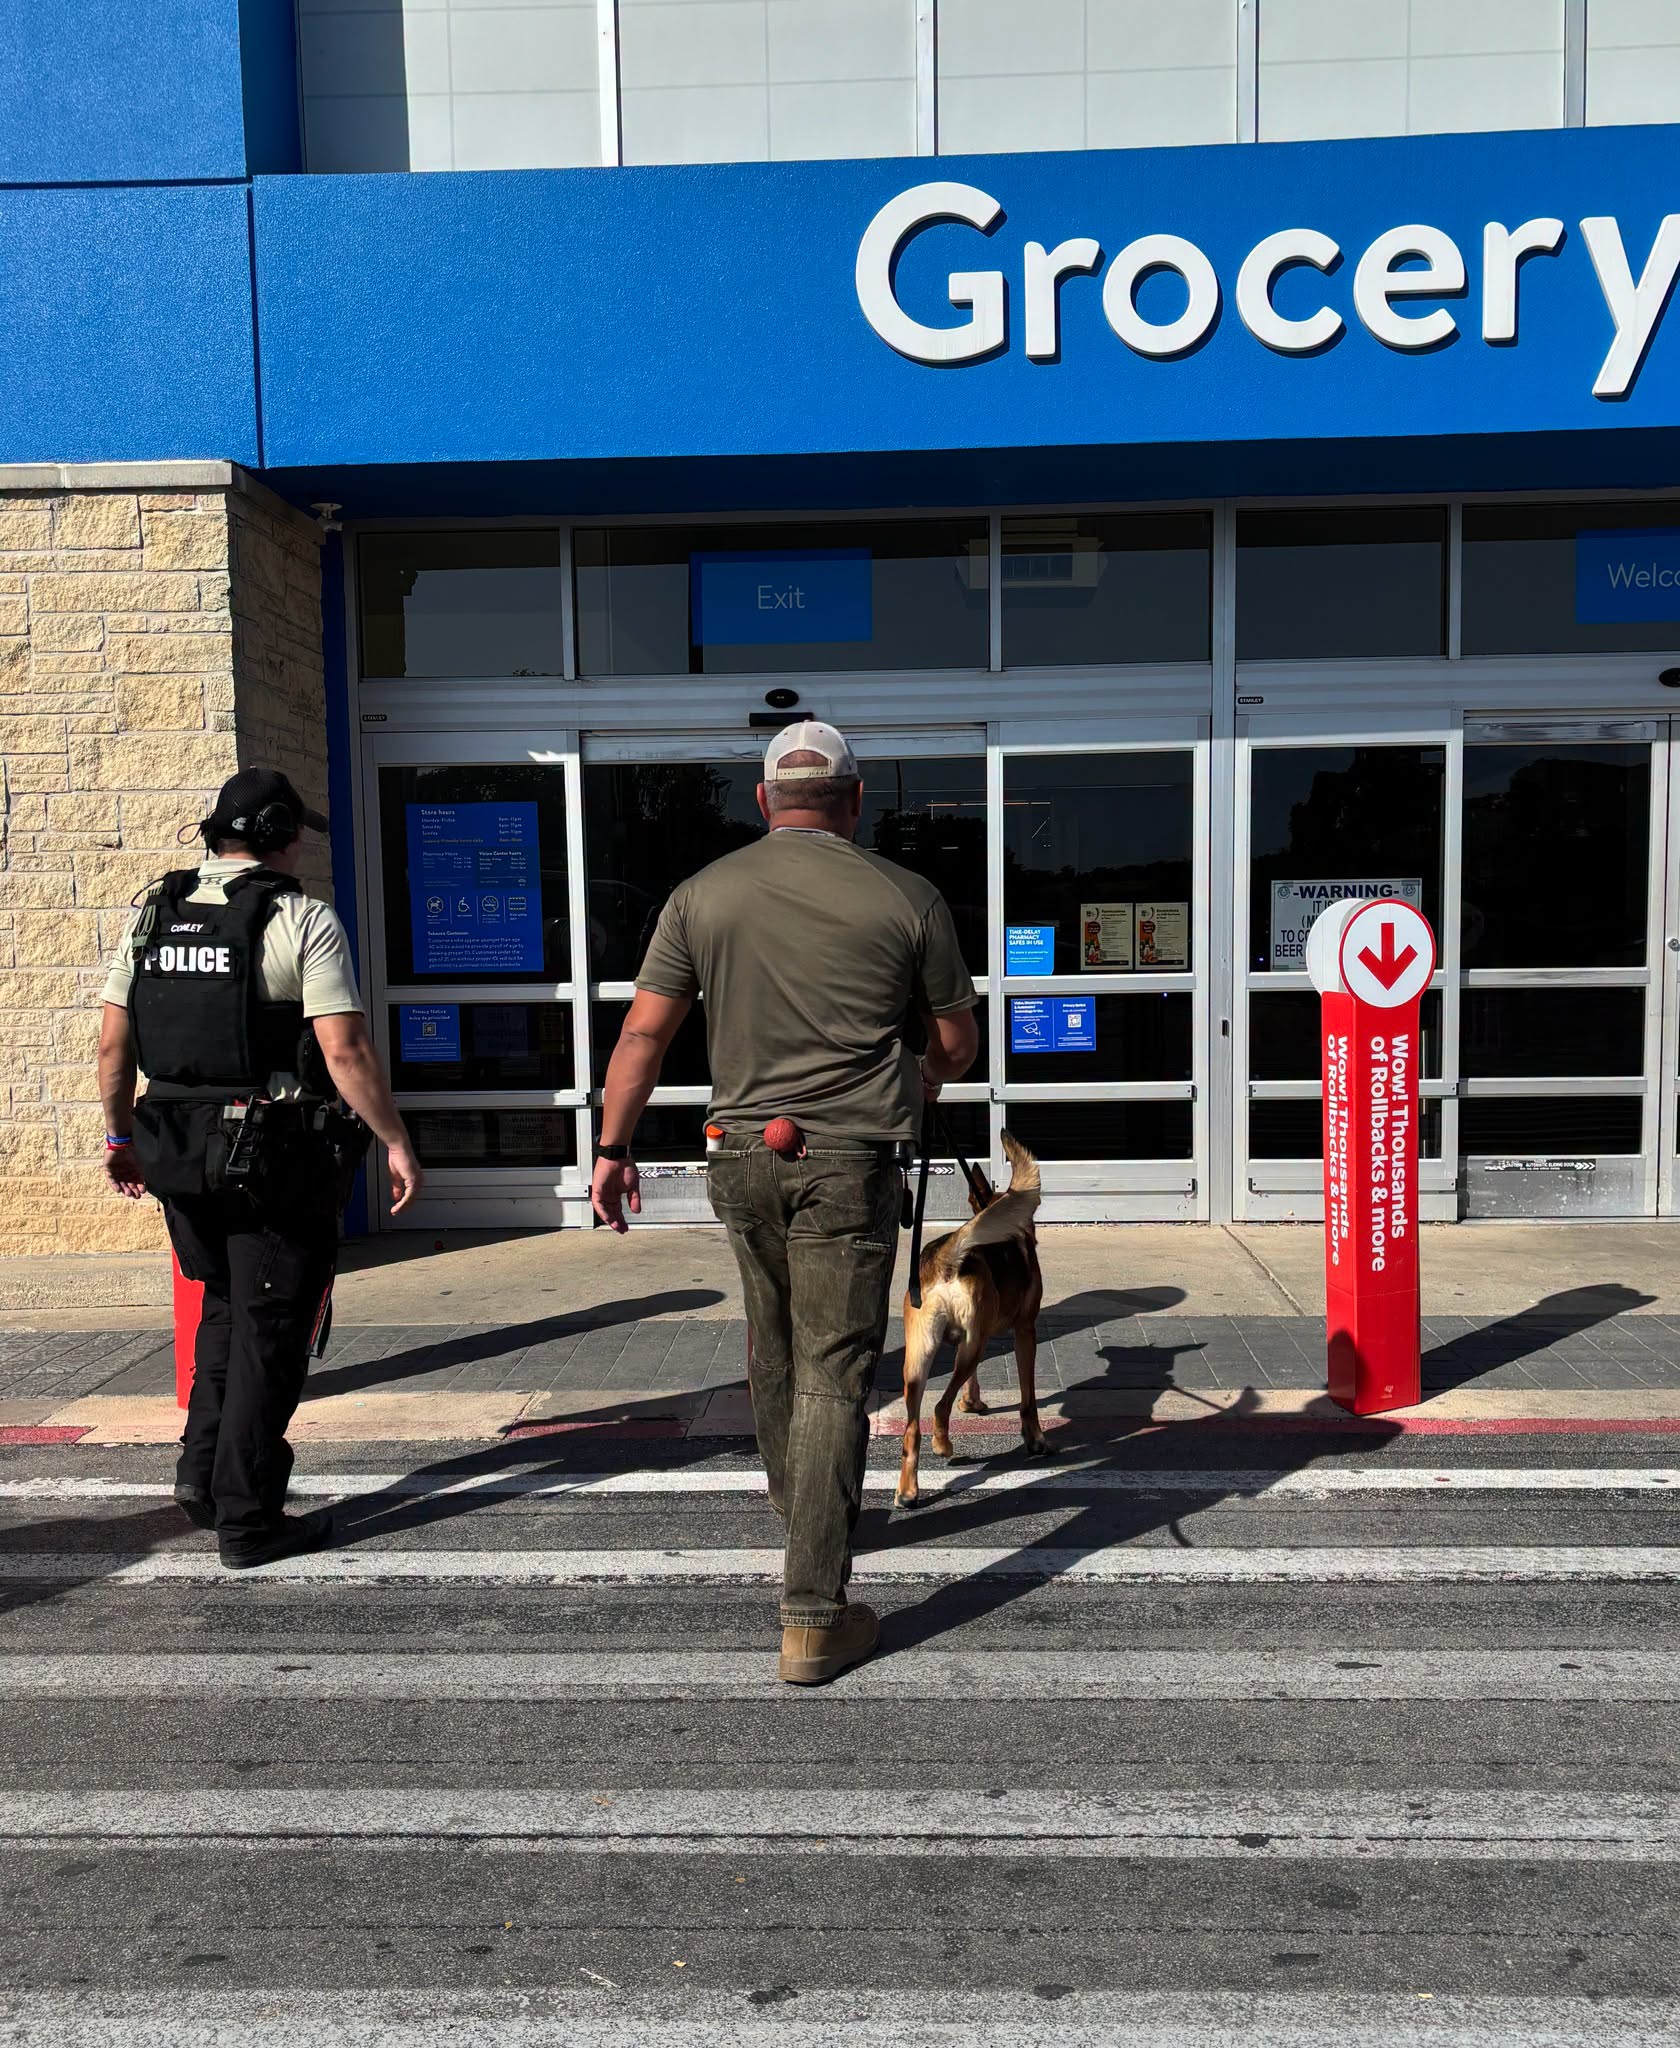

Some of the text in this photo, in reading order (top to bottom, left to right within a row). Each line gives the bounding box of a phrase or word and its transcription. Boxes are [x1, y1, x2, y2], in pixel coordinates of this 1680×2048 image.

[855, 181, 1680, 398] Grocery
[757, 584, 806, 610] Exit
[170, 922, 205, 934] CONLEY
[1275, 944, 1304, 958] BEER
[1281, 929, 1295, 943] TO
[1312, 900, 1322, 913] IT
[1327, 1033, 1340, 1267] of Rollbacks & more
[1336, 1035, 1349, 1240] Wow! Thousands
[1370, 1035, 1389, 1272] of Rollbacks & more
[1391, 1033, 1409, 1240] Wow! Thousands
